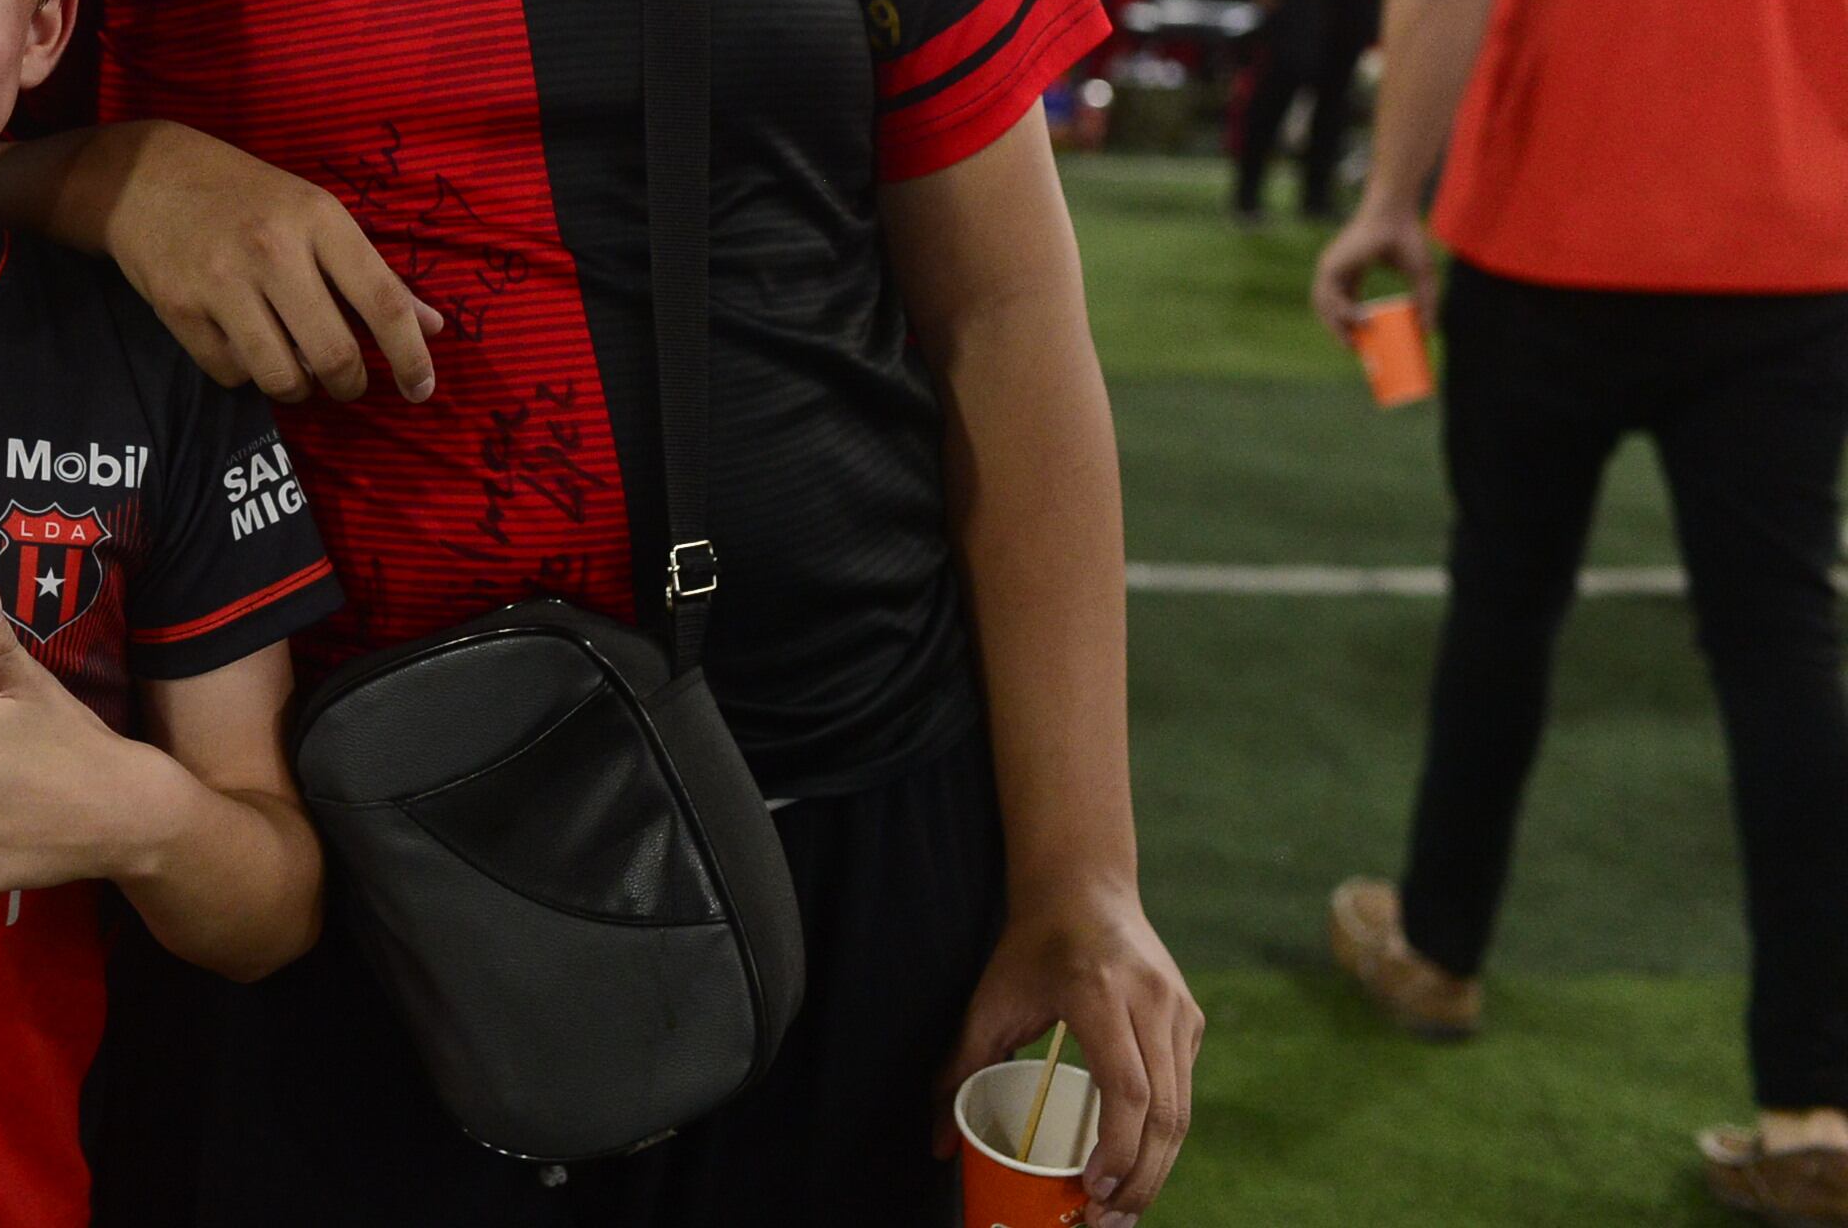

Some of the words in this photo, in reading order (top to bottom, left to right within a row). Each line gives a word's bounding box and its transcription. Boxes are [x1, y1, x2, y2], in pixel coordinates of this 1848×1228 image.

[6, 437, 149, 490] Mobil
[20, 520, 87, 541] LDA
[230, 479, 307, 541] MIG
